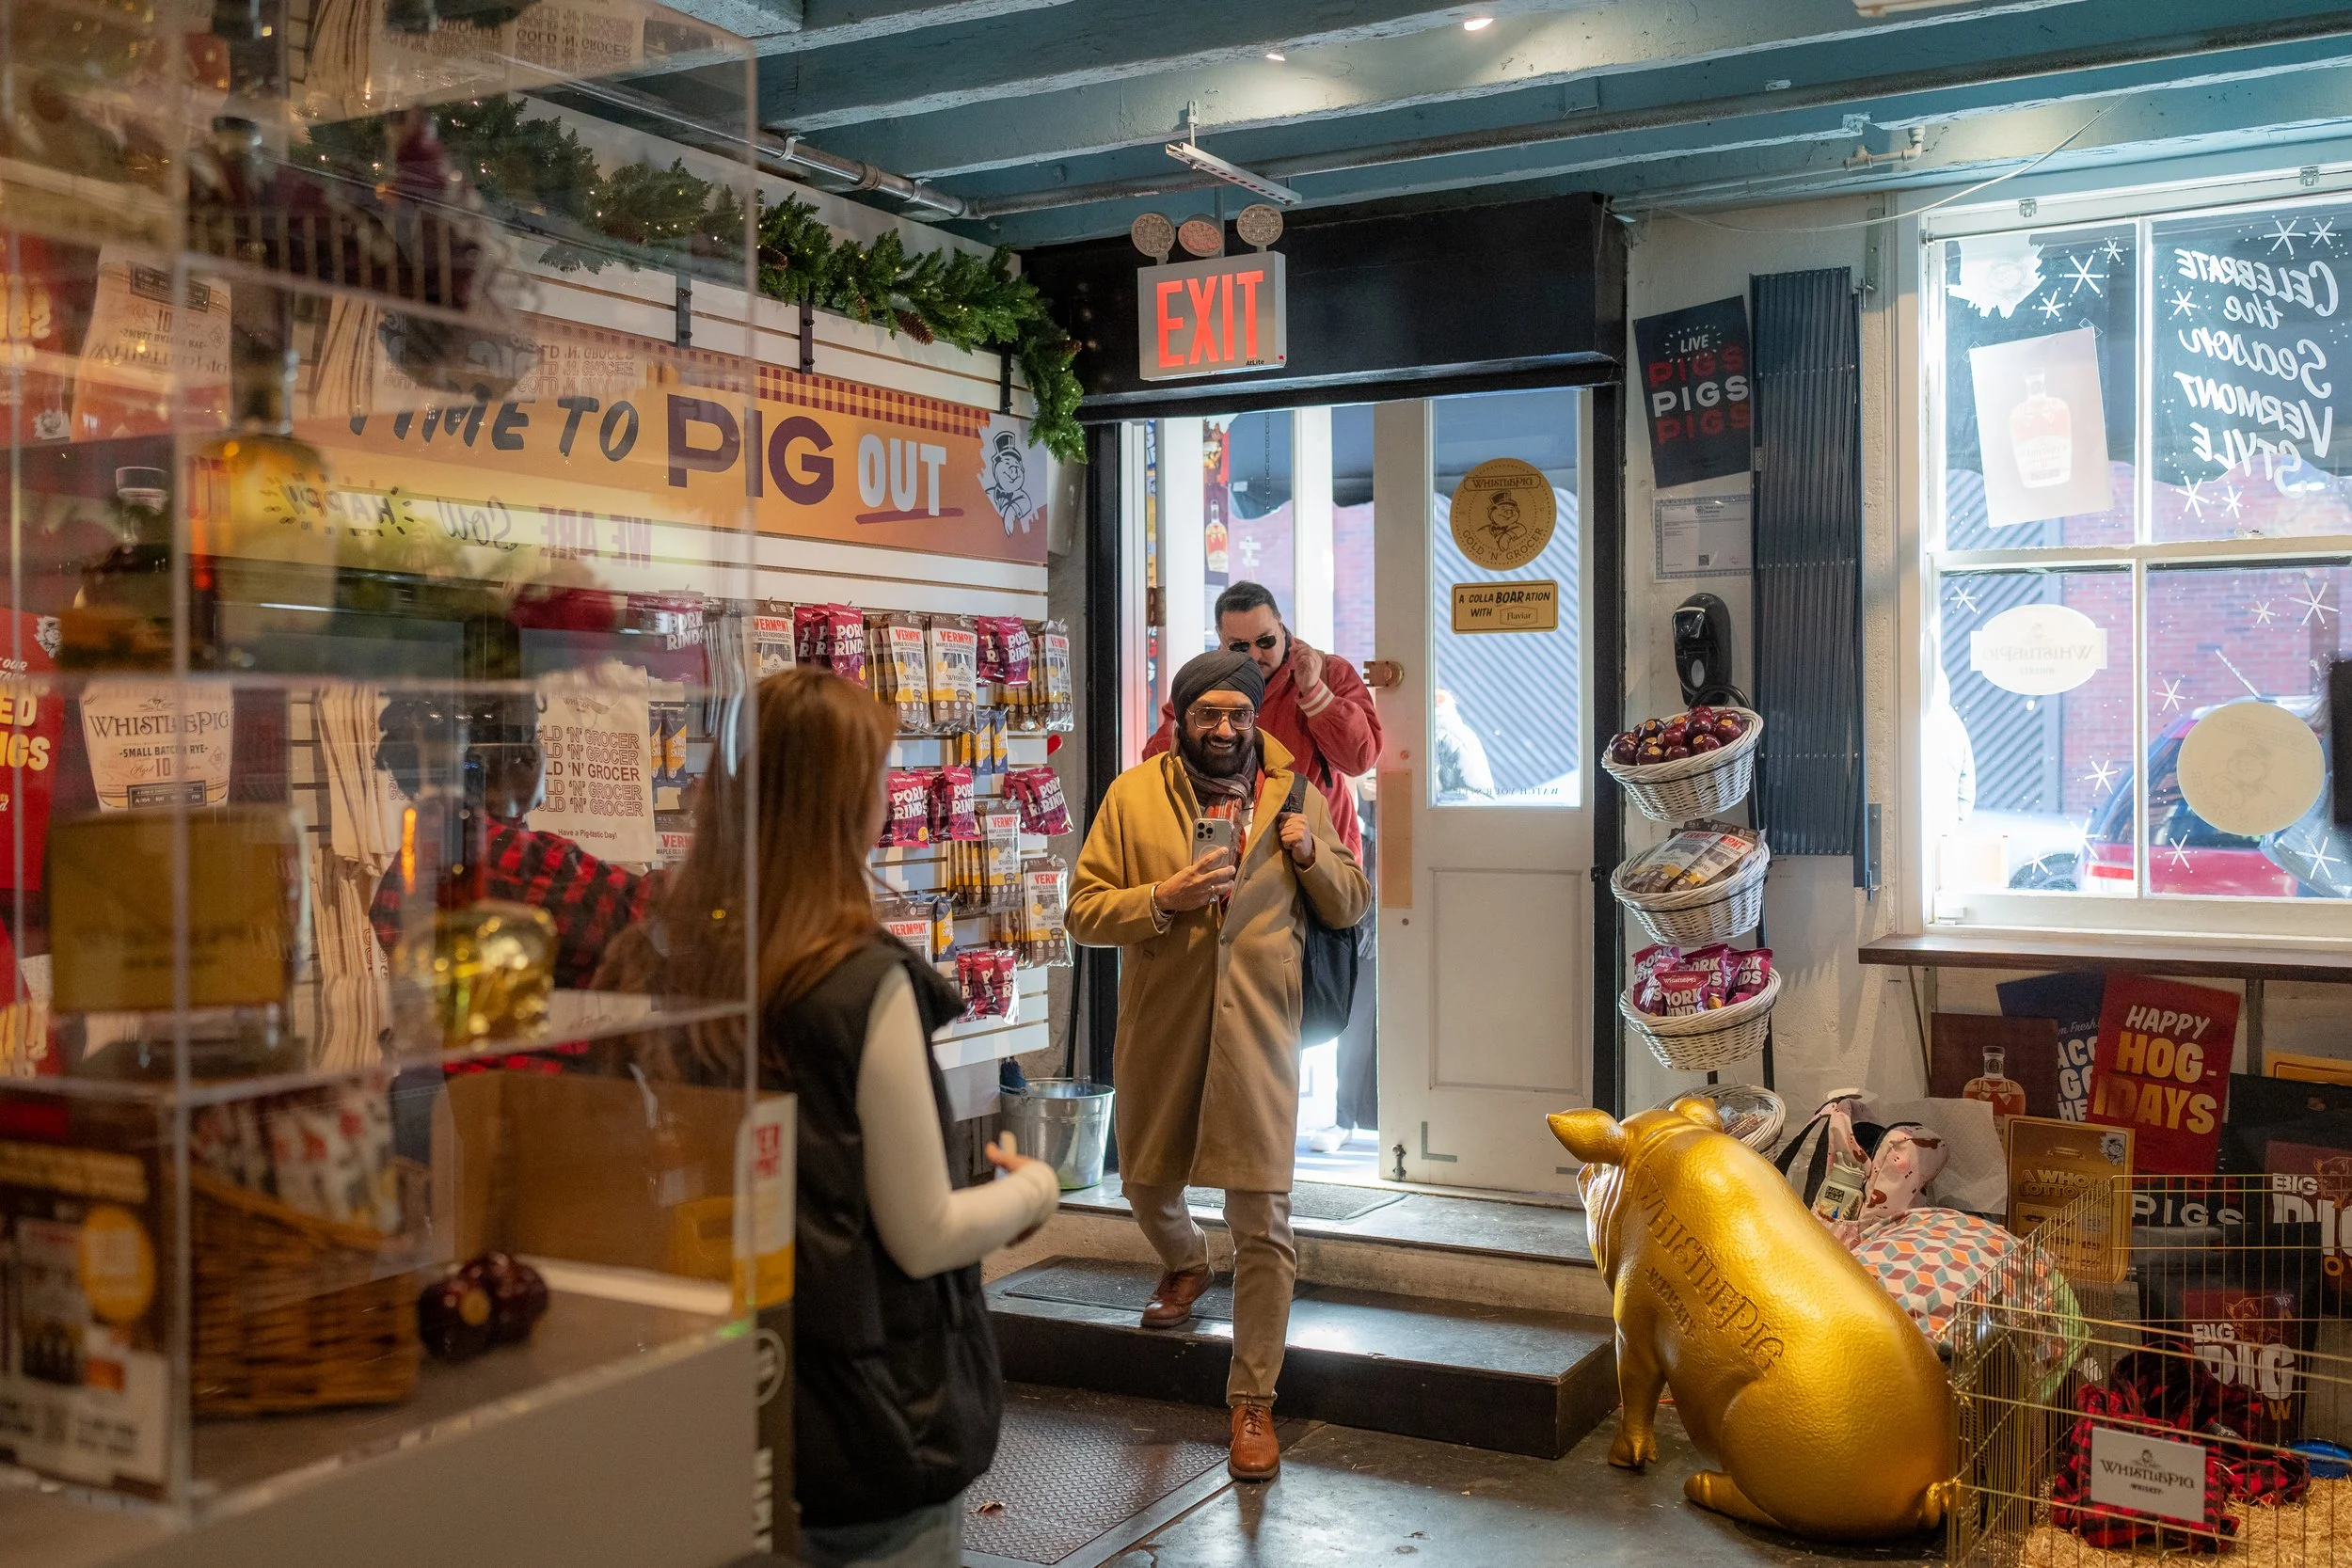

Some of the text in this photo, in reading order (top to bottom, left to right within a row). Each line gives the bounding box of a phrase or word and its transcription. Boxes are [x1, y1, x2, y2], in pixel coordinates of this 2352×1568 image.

[1157, 270, 1264, 368] EXIT
[1680, 335, 1709, 354] LIVE
[1647, 344, 1745, 389] PIGS
[1652, 375, 1750, 417] PIGS
[557, 395, 640, 463] TO
[667, 393, 835, 506] PIG
[857, 434, 946, 516] OUT
[1462, 530, 1485, 556] GOLD
[1506, 527, 1544, 561] GROCER
[1459, 594, 1465, 604] A
[1470, 608, 1493, 617] WITH
[1506, 612, 1532, 621] Flaviar
[585, 729, 640, 750] GROCER
[155, 757, 170, 777] 10
[586, 746, 640, 767] GROCER
[588, 763, 641, 782] GROCER
[588, 782, 644, 800] GROCER
[590, 799, 644, 816] GROCER
[2125, 1005, 2211, 1039] HAPPY
[2118, 1031, 2217, 1084] HOG-
[2272, 1173, 2318, 1196] BIG
[1643, 1164, 1785, 1375] WHISTLEPIG
[2191, 1323, 2235, 1344] BIG
[2100, 1459, 2195, 1489] WHISTLEPIG
